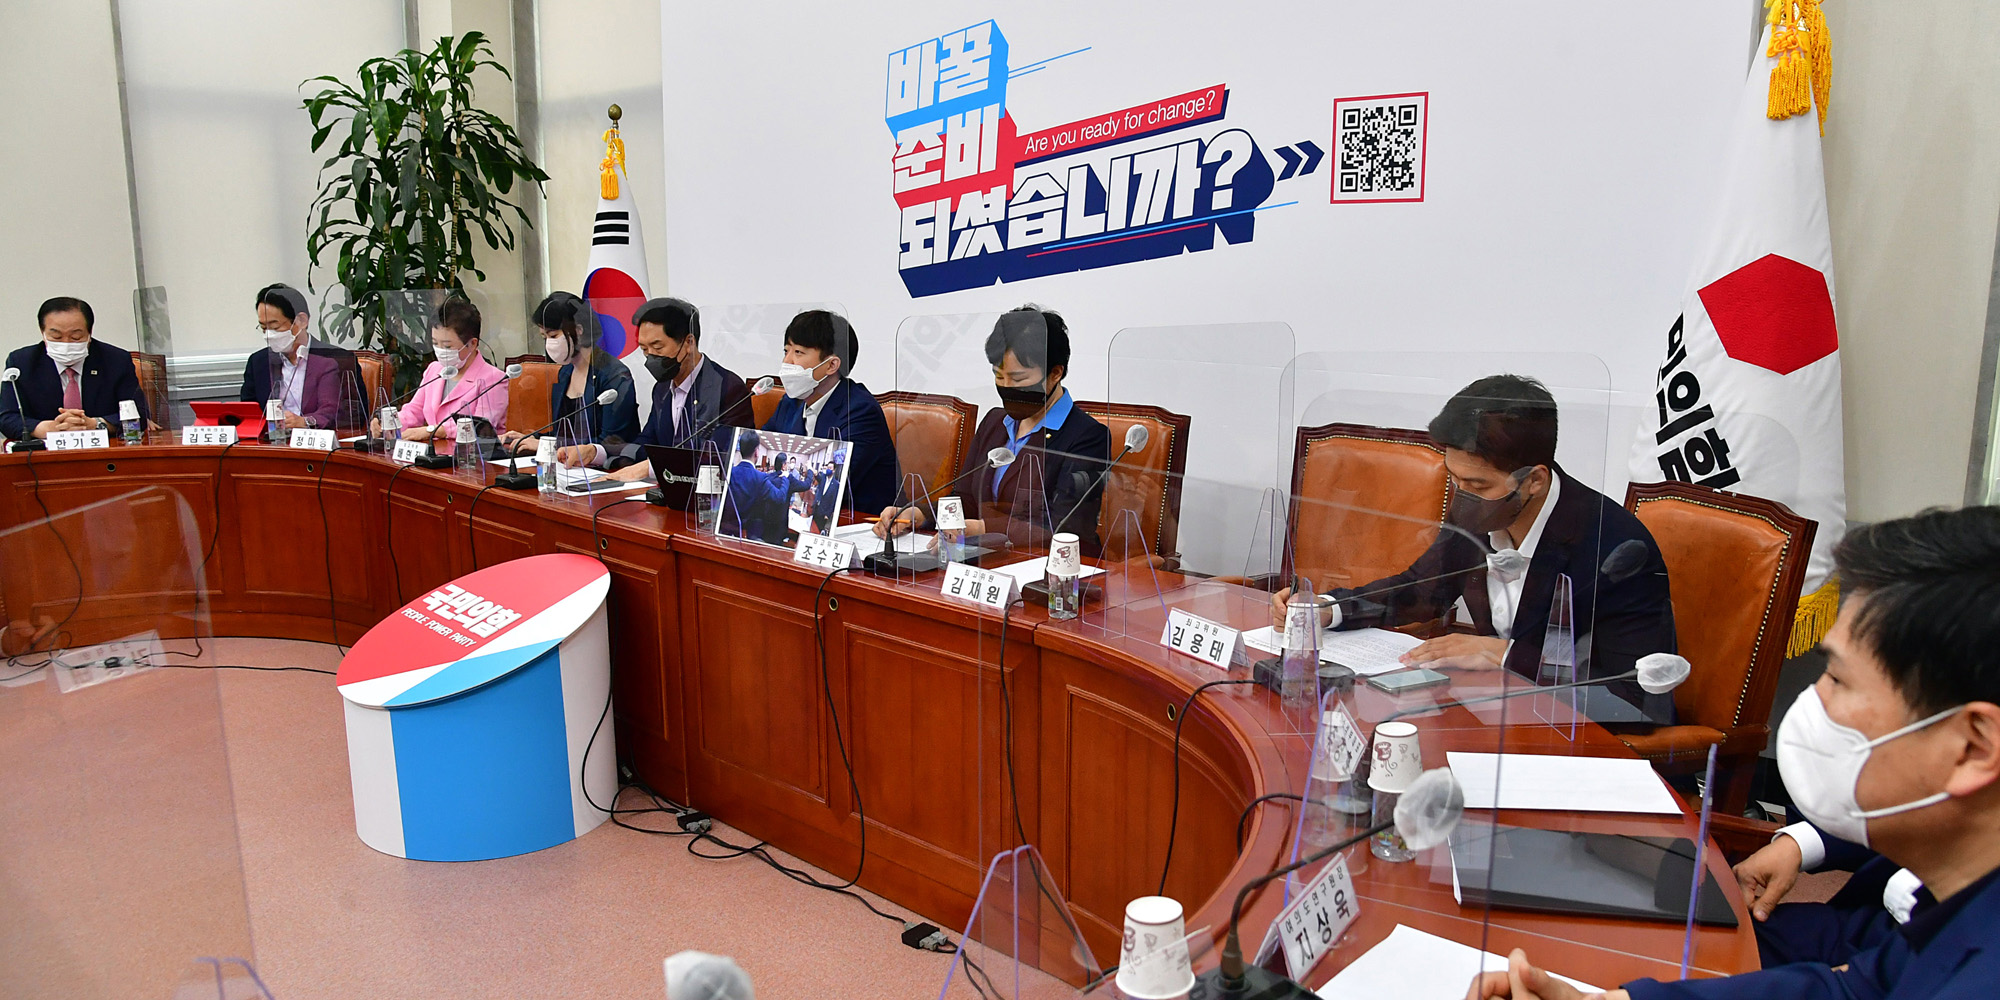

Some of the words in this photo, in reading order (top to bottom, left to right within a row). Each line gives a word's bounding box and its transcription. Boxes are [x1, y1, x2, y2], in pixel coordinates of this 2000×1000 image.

[885, 19, 997, 120] 바꿀
[1024, 136, 1048, 155] Are
[1051, 129, 1077, 152] you
[1080, 117, 1121, 141] ready
[1123, 112, 1145, 131] for
[1147, 89, 1216, 125] change?
[893, 102, 1001, 194] 준비
[898, 127, 1256, 271] 되셨습니까?
[55, 437, 102, 450] 한기호
[189, 433, 228, 444] 김도읍
[801, 545, 844, 568] 조수진
[422, 583, 523, 639] 국민의힘
[950, 577, 1000, 604] 김재원
[401, 607, 430, 624] PEOPLE
[424, 620, 454, 637] POWER
[448, 632, 477, 647] PARTY
[1171, 626, 1225, 662] 김용태
[1185, 618, 1219, 636] 최고위원
[1284, 865, 1344, 934] 여의도연구원장
[1295, 888, 1351, 967] 지상욱
